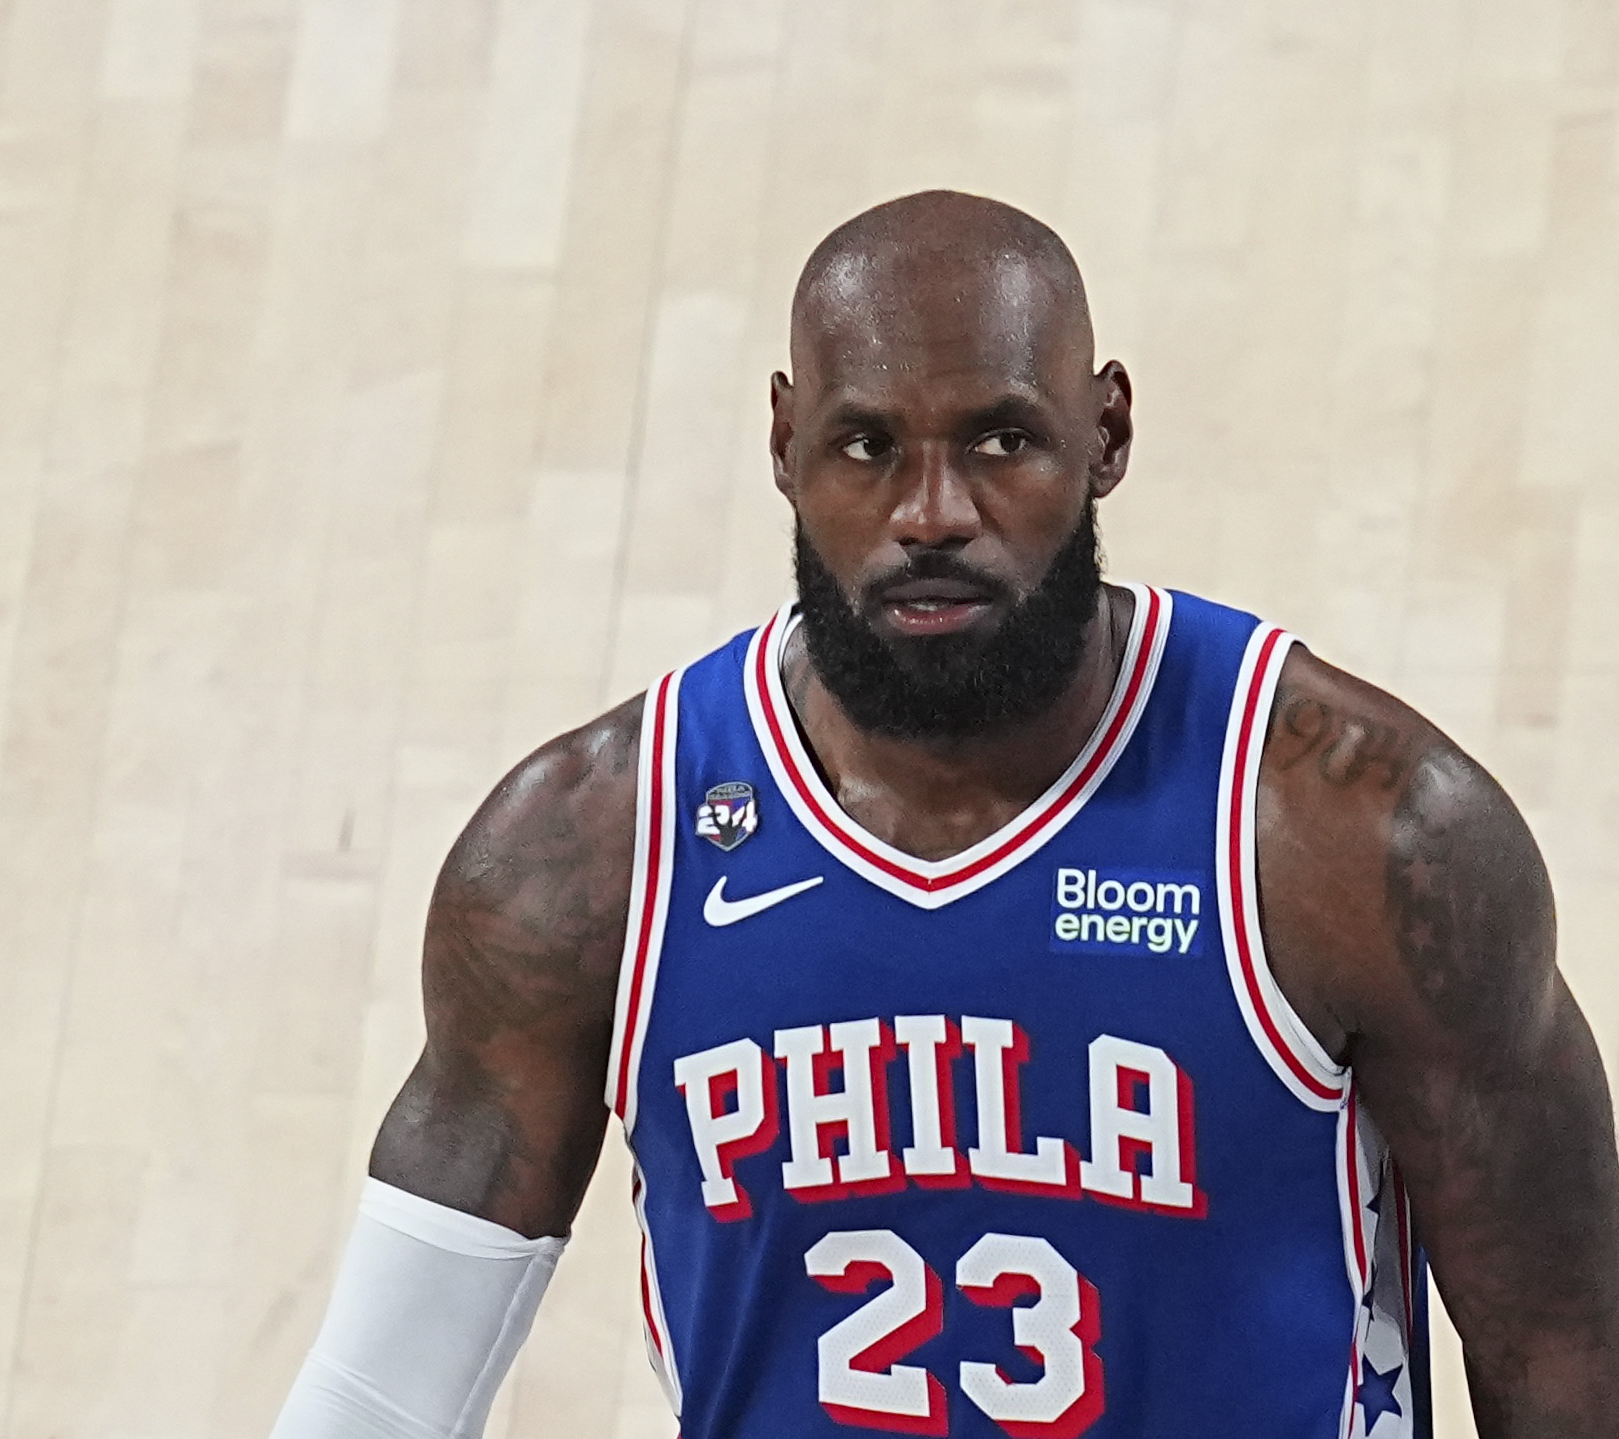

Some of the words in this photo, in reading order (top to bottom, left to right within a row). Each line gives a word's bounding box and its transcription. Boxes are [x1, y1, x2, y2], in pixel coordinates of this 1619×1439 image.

[1057, 868, 1200, 915] Bloom
[1055, 913, 1199, 954] energy
[674, 1014, 1207, 1222] PHILA
